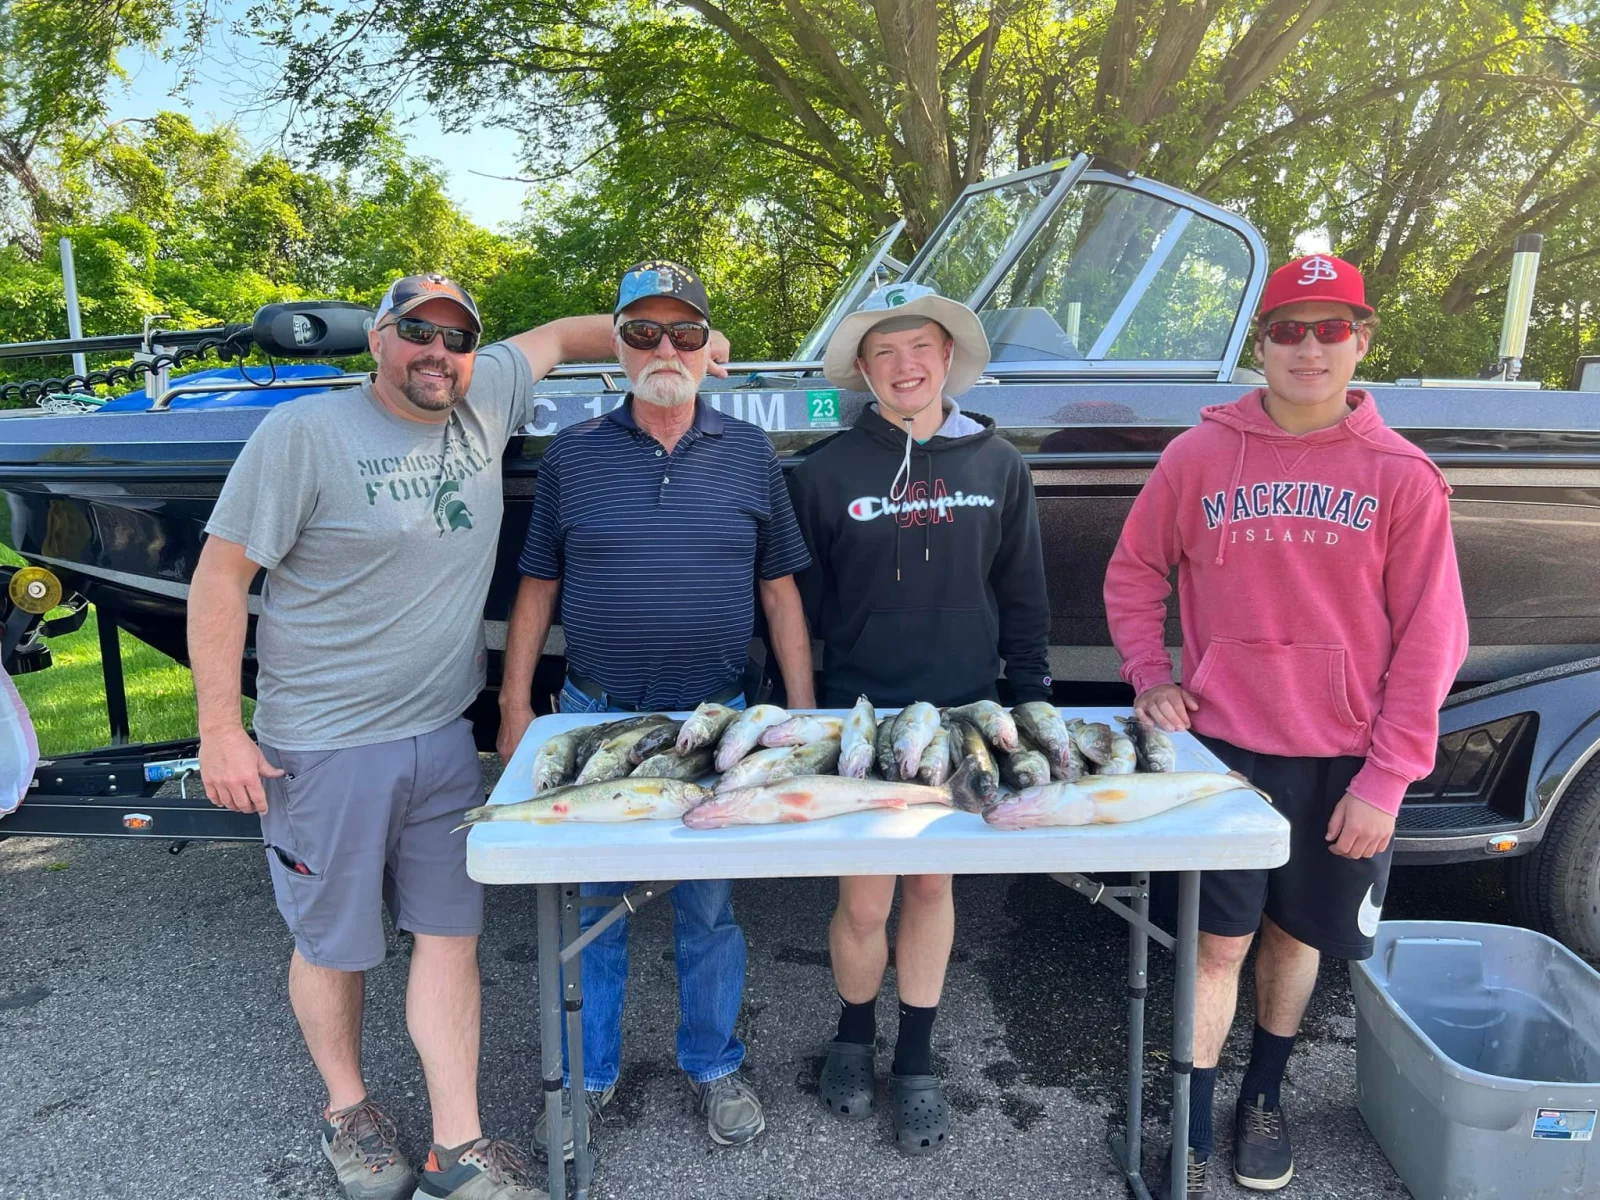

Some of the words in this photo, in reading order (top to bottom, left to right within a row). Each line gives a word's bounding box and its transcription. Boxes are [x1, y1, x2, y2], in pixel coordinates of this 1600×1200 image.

[513, 397, 558, 436] C
[812, 398, 835, 417] 23
[847, 490, 995, 522] Champion
[1202, 481, 1378, 532] MACKINAC
[1230, 528, 1339, 545] ISLAND
